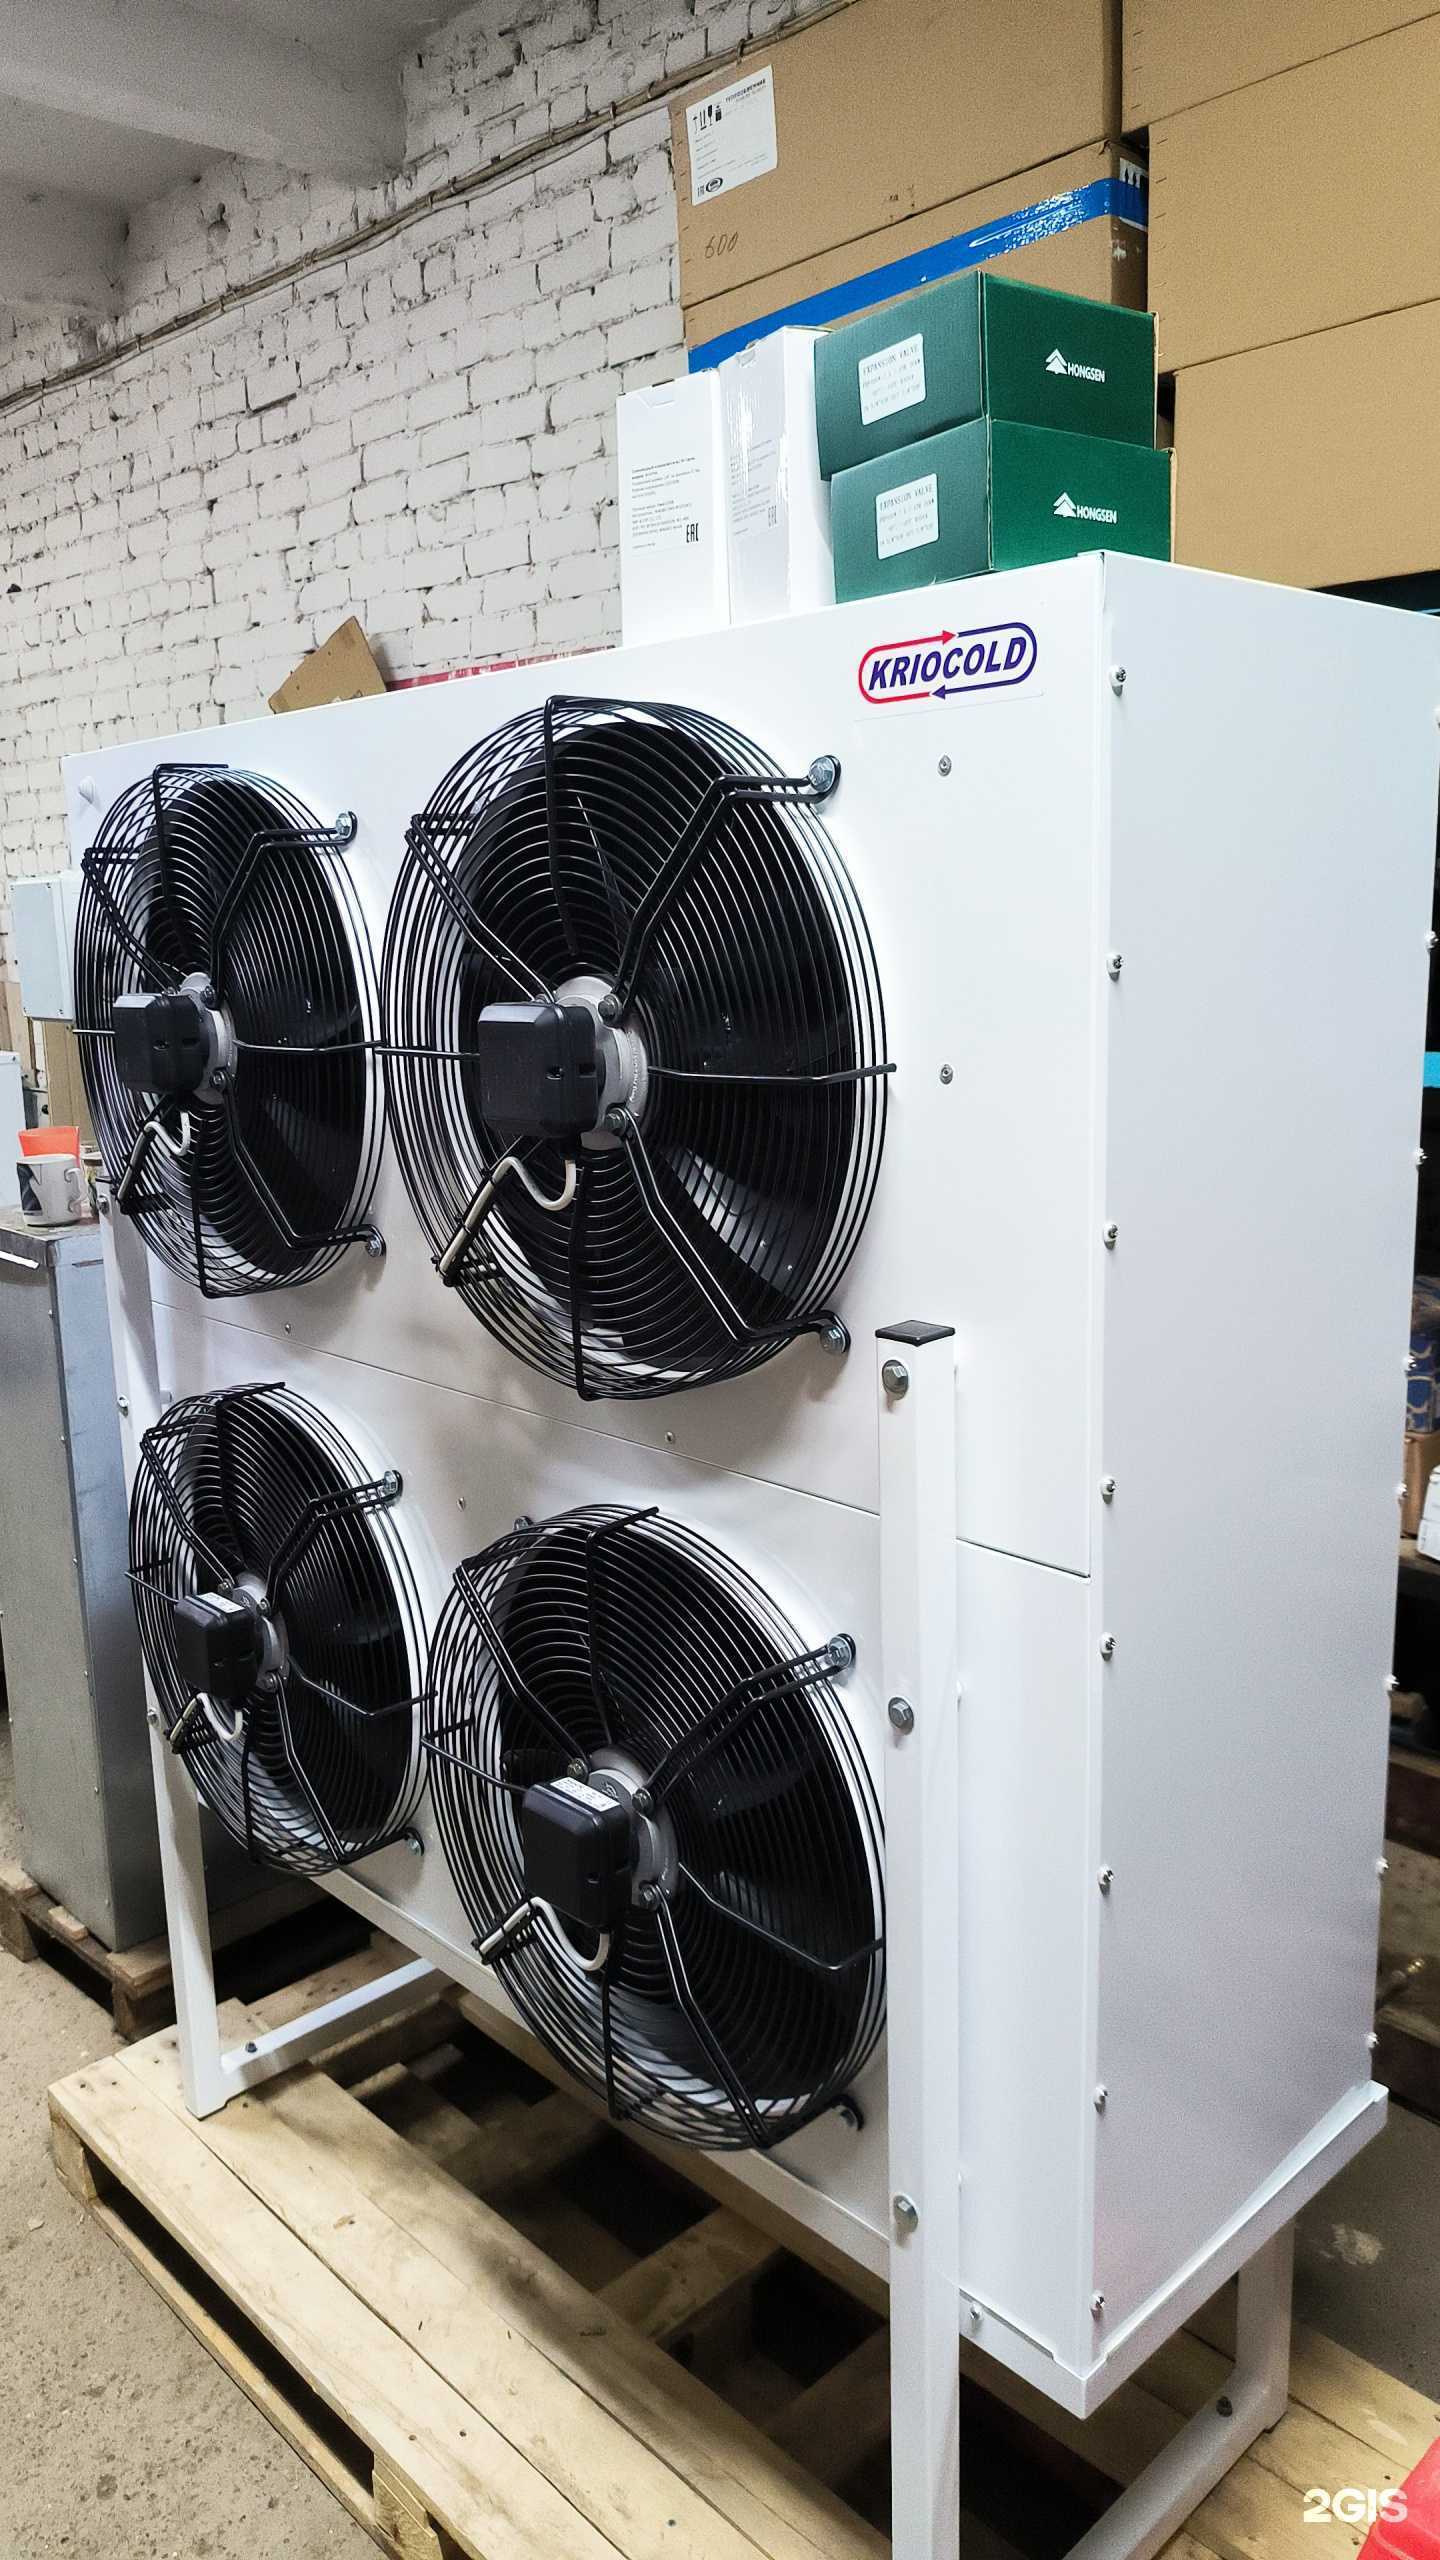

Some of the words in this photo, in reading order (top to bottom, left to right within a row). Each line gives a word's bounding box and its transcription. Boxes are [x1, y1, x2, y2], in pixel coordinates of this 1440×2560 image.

[1067, 362, 1106, 383] HONGSEN
[1076, 504, 1117, 524] HONGSEN
[868, 636, 1027, 690] KRIOCOLD
